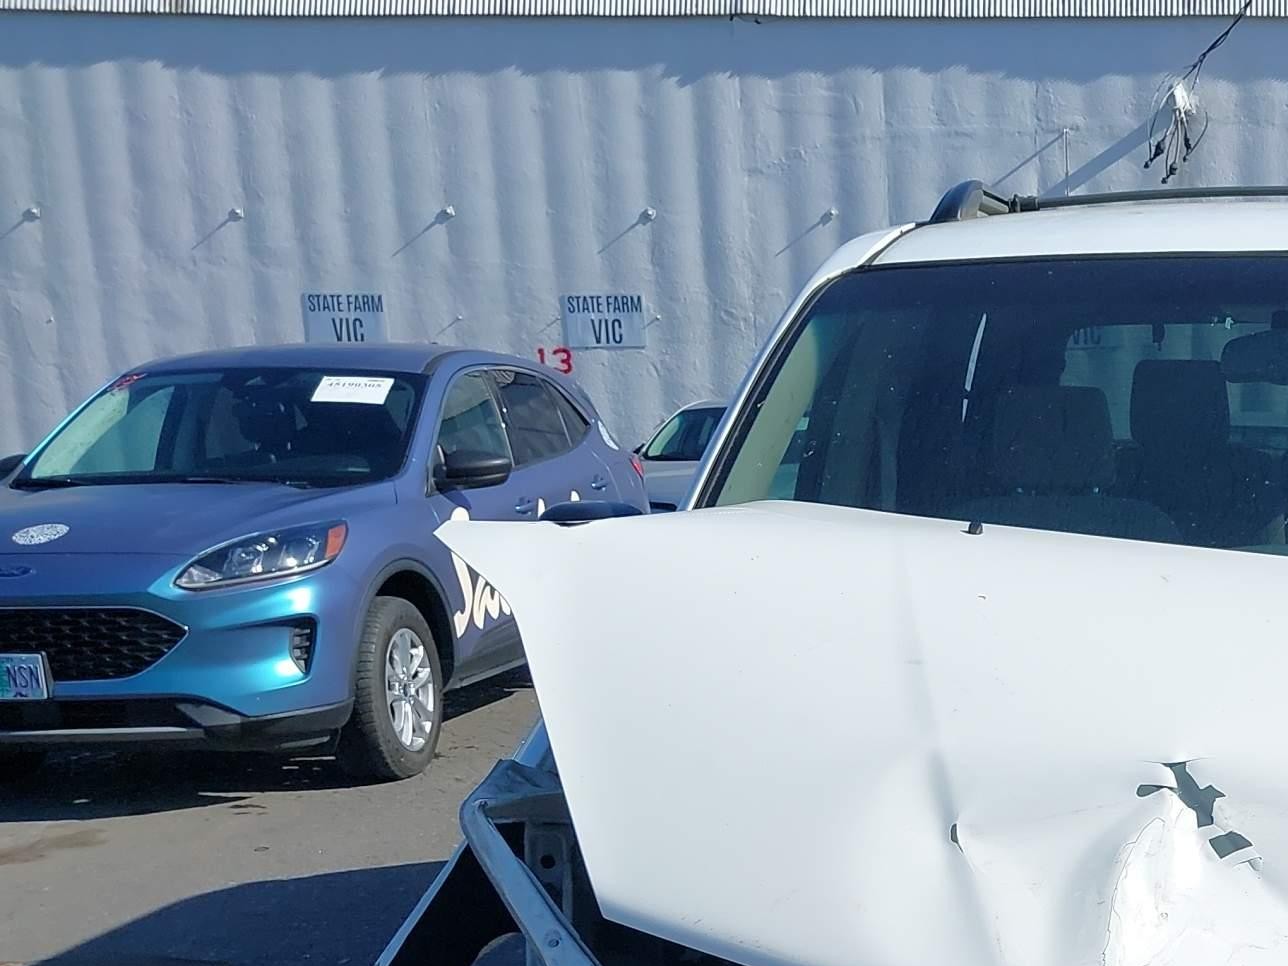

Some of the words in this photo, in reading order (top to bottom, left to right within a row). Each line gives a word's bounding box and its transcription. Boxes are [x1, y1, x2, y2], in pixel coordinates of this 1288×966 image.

[307, 294, 344, 313] STATE
[346, 294, 384, 313] FARM
[567, 295, 604, 314] STATE
[606, 295, 642, 313] FARM
[330, 317, 365, 343] VIC
[590, 318, 624, 345] VIC
[6, 664, 43, 689] NSN
